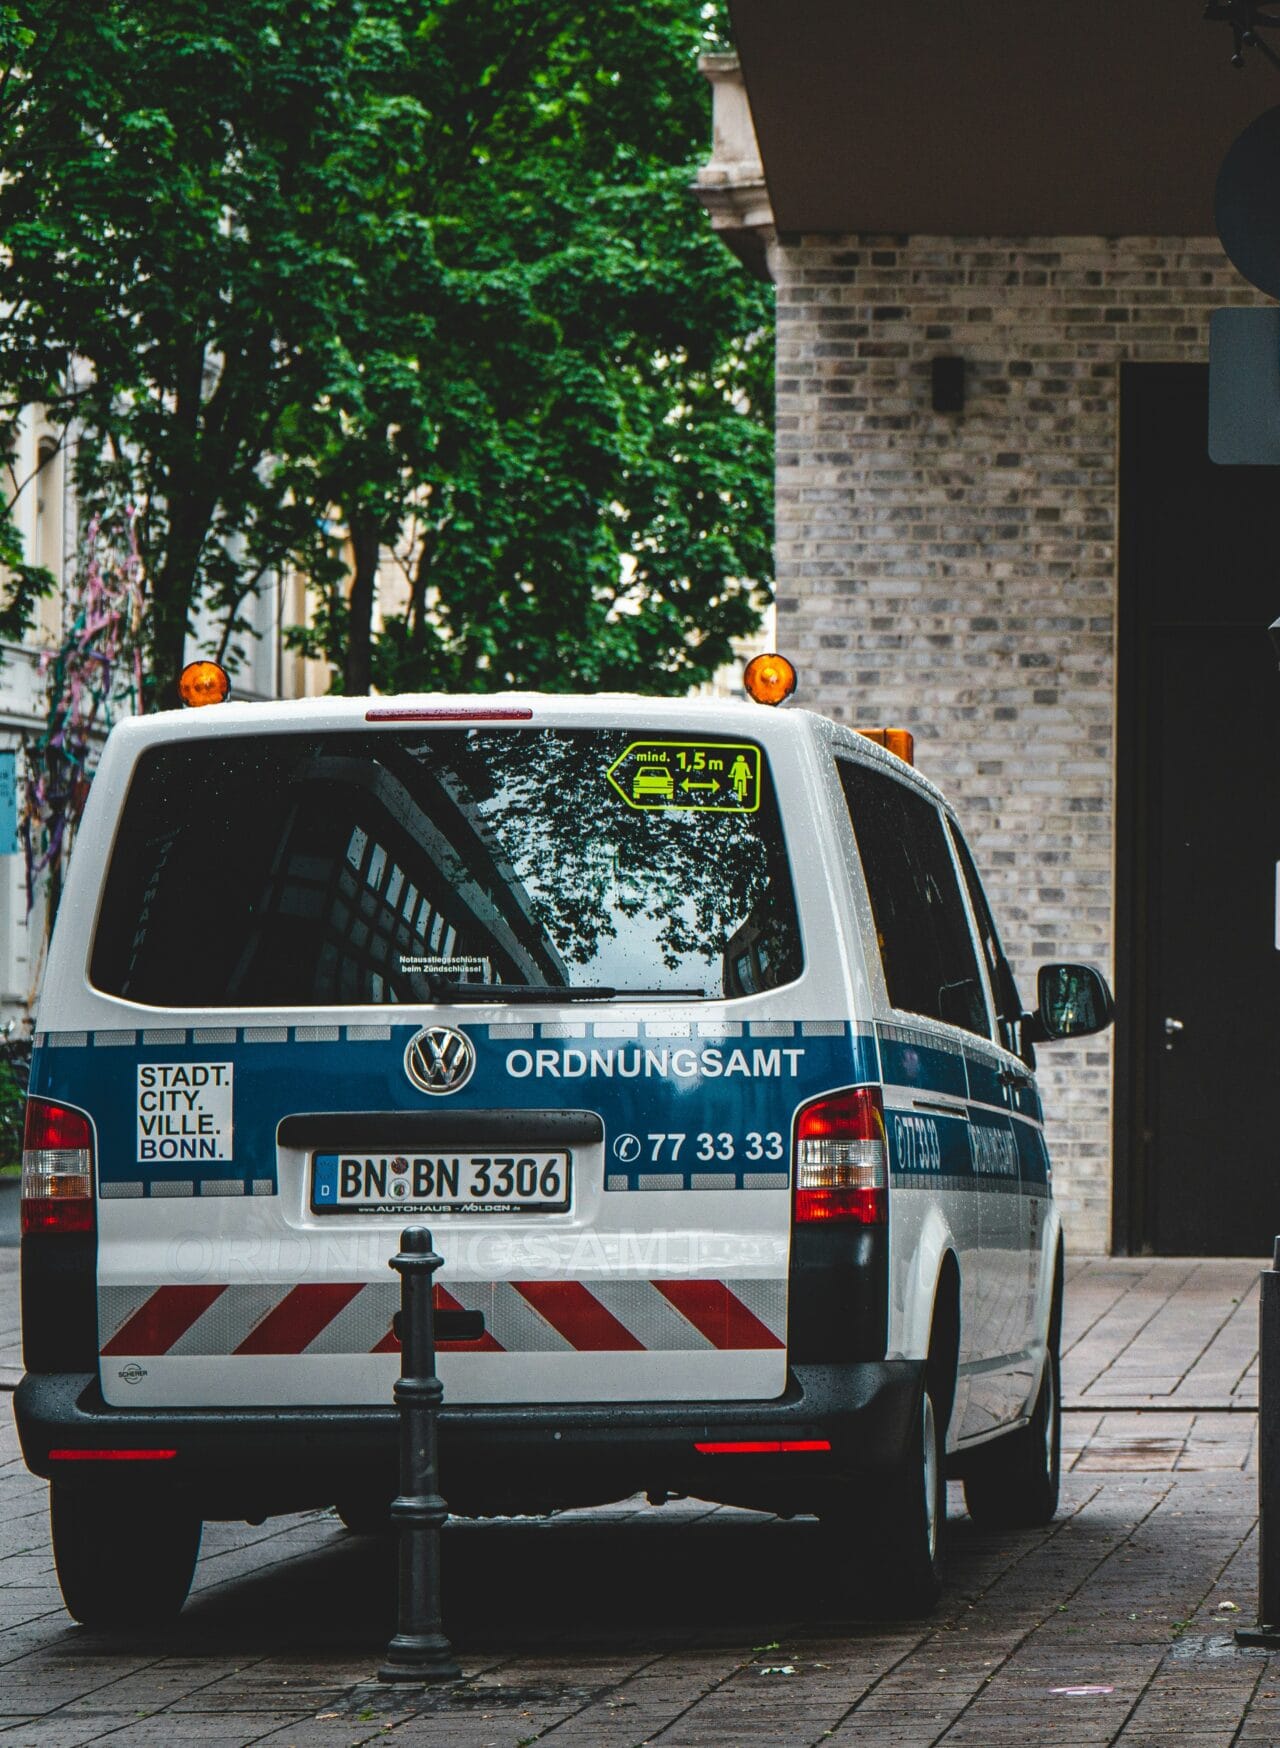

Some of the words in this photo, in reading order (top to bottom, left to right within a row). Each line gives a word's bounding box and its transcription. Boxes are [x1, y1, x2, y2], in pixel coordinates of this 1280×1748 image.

[636, 750, 671, 763] mind.
[675, 751, 707, 774] 1,5
[708, 758, 724, 771] m
[399, 954, 489, 967] Notausstiegsschlüssel
[401, 964, 422, 974] beim
[423, 964, 482, 974] Zündschlüssel
[505, 1047, 806, 1079] ORDNUNGSAMT
[139, 1065, 231, 1088] STADT.
[139, 1089, 205, 1113] CITY.
[139, 1113, 222, 1137] VILLE.
[139, 1136, 226, 1160] BONN.
[647, 1133, 686, 1162] 77
[695, 1132, 736, 1161] 33
[744, 1131, 784, 1161] 33
[340, 1158, 387, 1198] BN
[412, 1158, 459, 1198] BN
[469, 1158, 561, 1198] 3306
[320, 1184, 330, 1197] D
